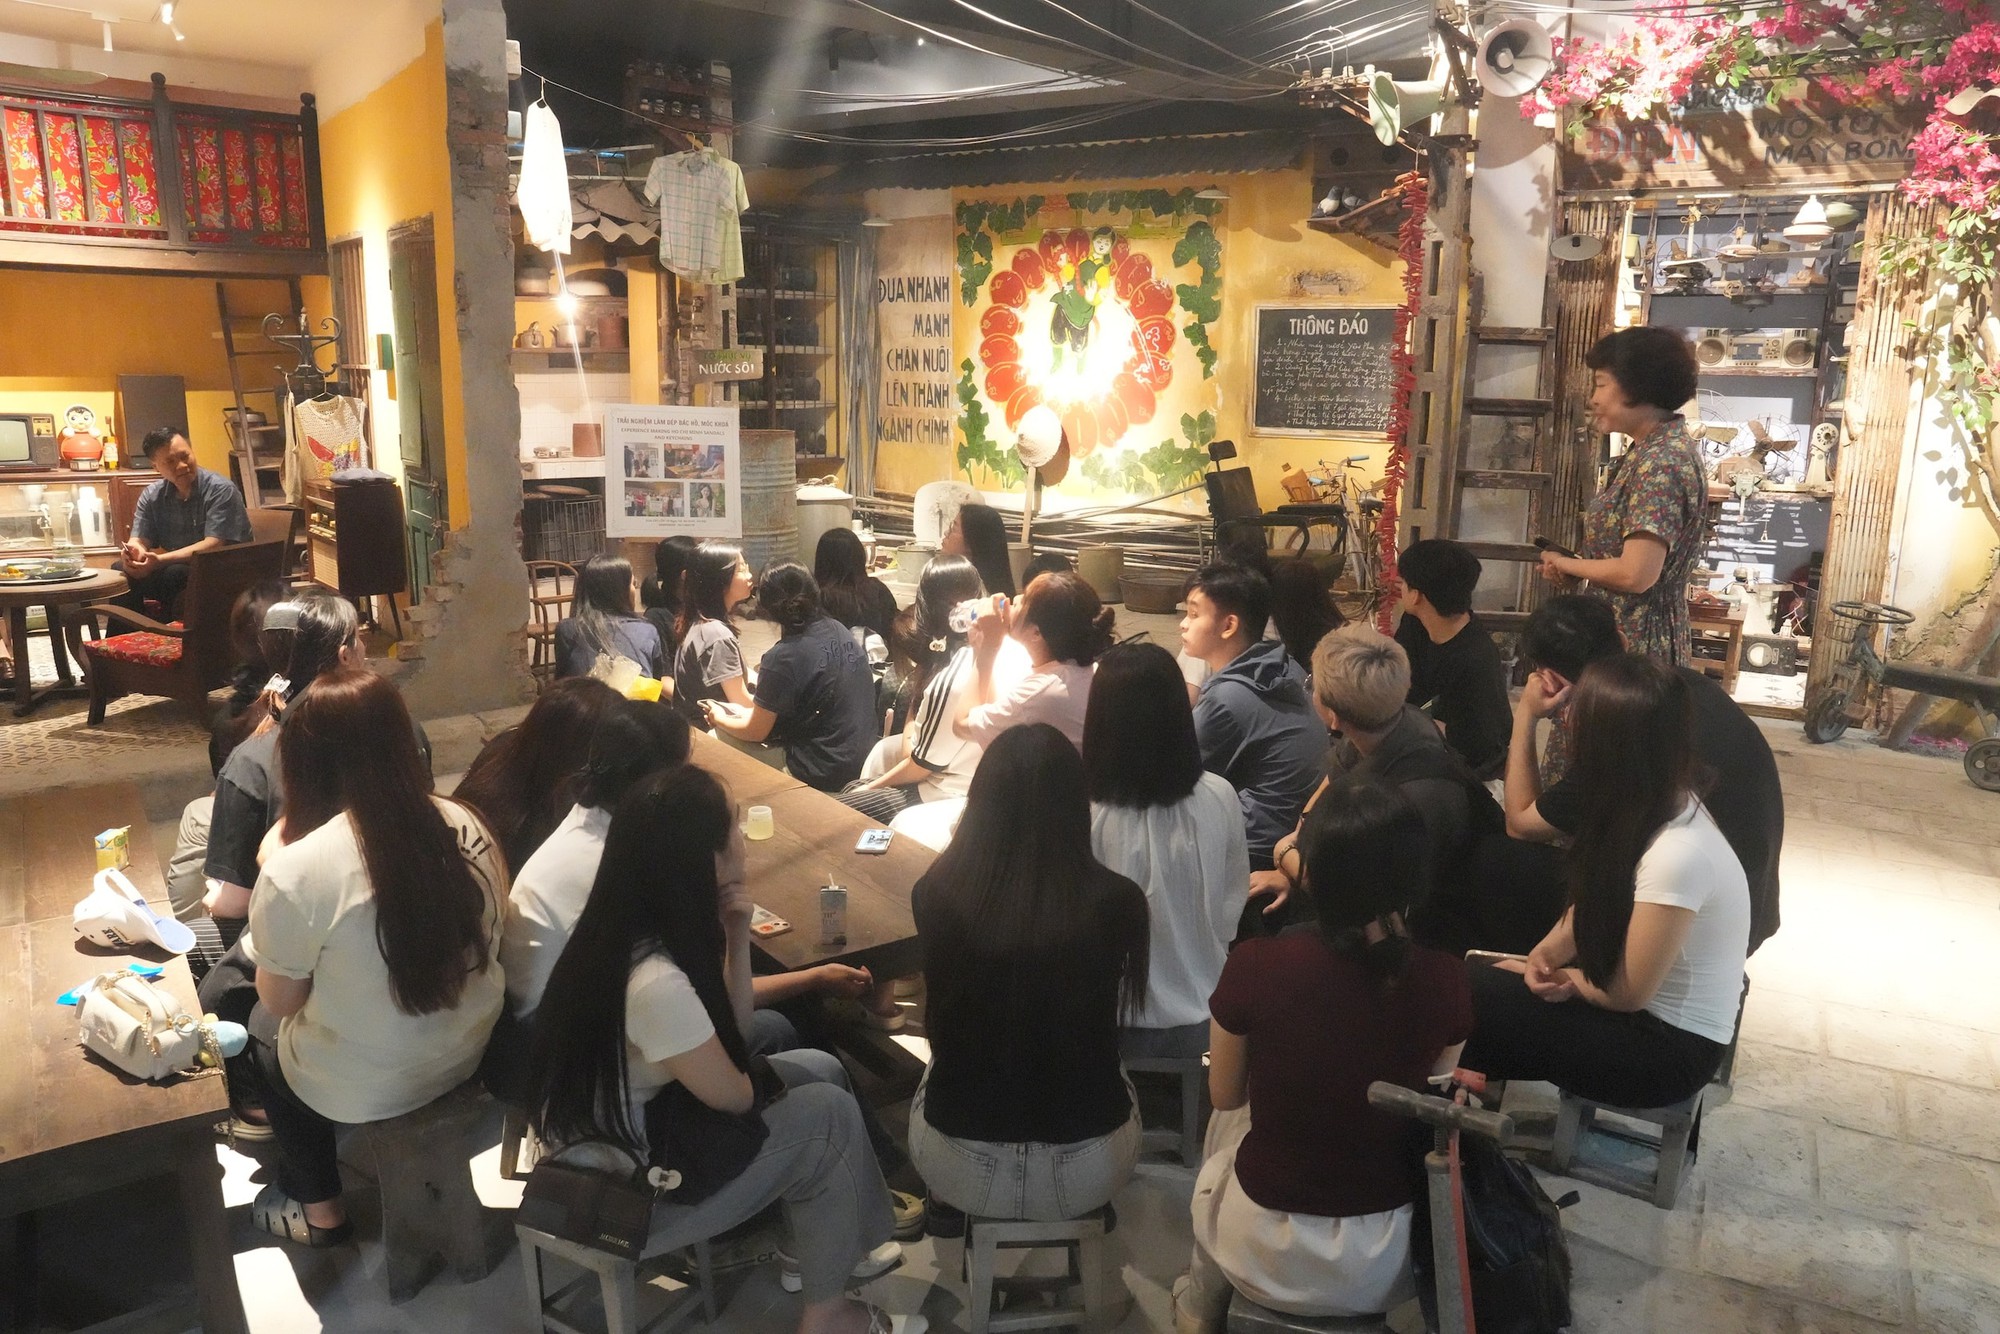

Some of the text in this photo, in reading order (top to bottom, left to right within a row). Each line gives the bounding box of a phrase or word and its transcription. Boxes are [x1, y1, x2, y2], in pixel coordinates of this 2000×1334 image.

[907, 276, 949, 303] NHANH
[912, 314, 949, 338] MẠNH
[1289, 312, 1369, 336] THÔNG BÁO
[699, 360, 732, 374] NƯỚC
[923, 346, 949, 372] NUÔI
[886, 379, 949, 408] LÊN THÀNH
[916, 416, 949, 445] CHÍNH
